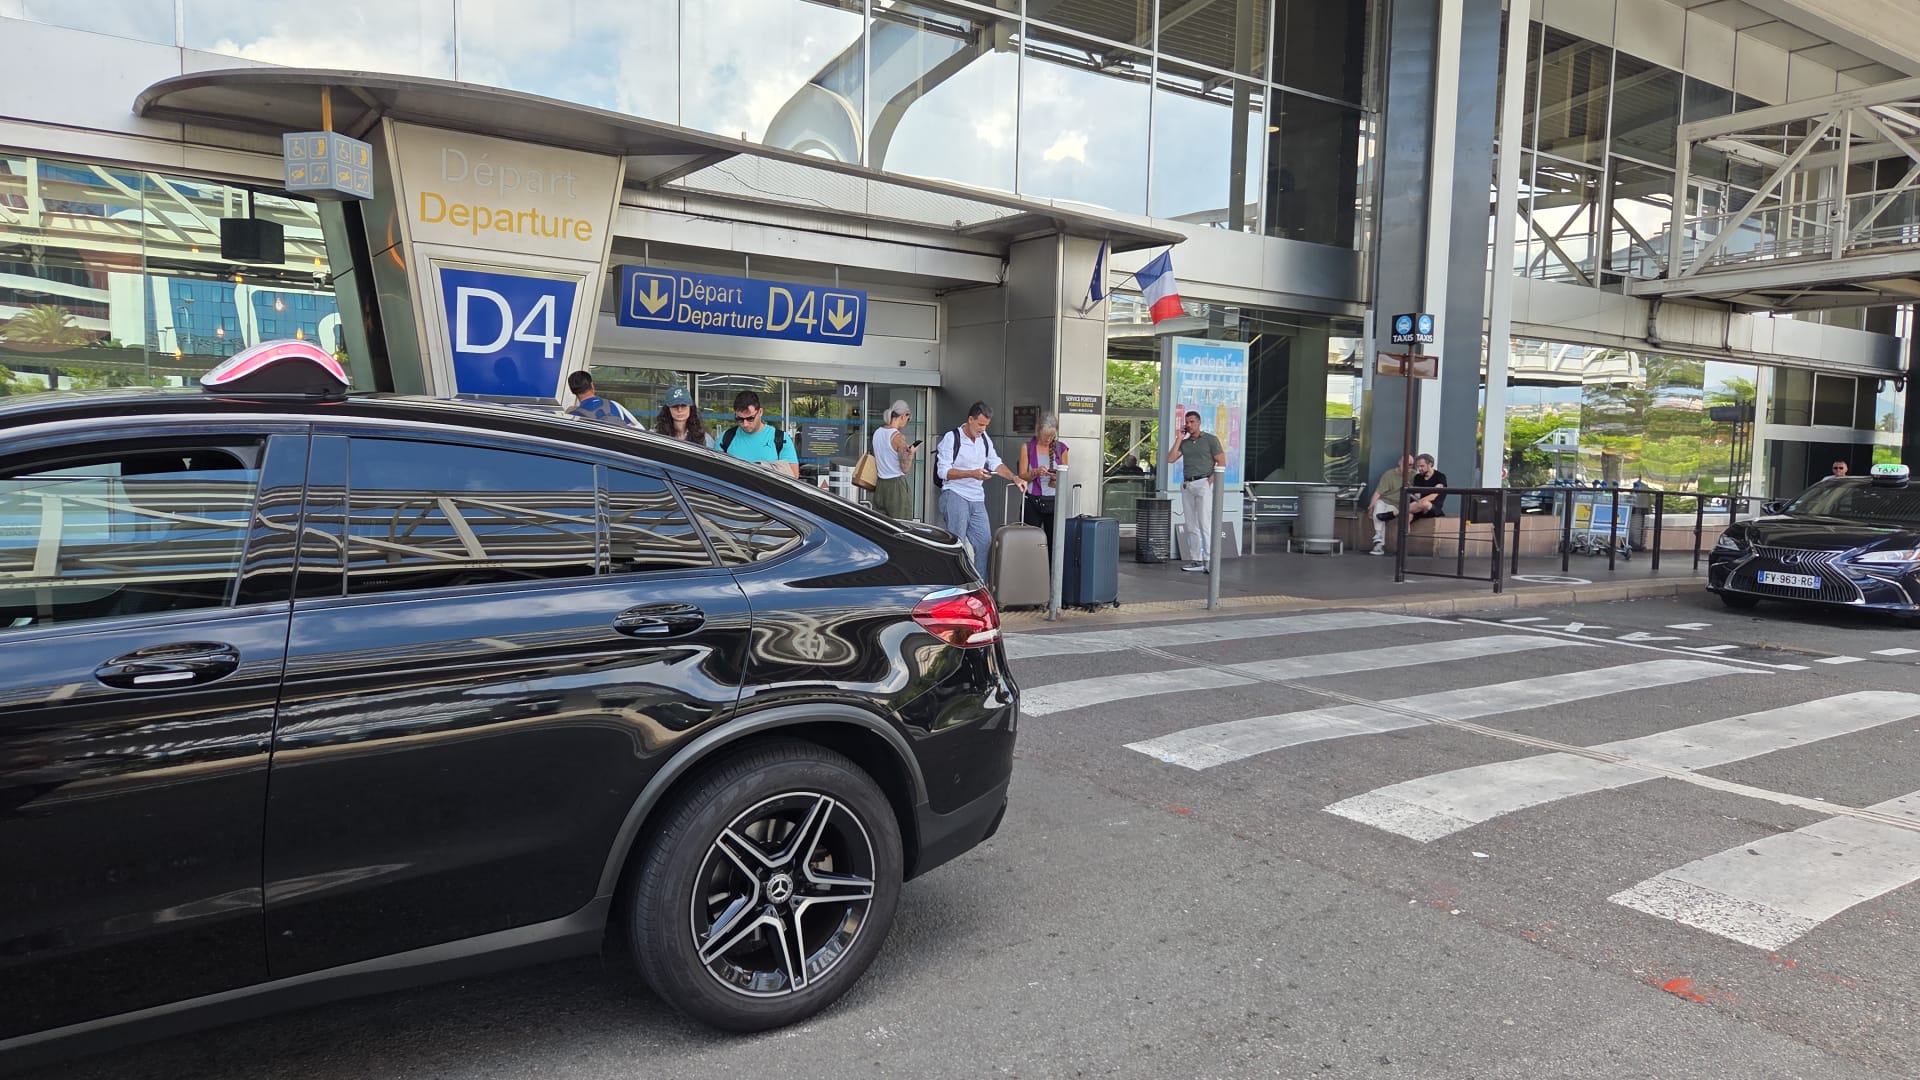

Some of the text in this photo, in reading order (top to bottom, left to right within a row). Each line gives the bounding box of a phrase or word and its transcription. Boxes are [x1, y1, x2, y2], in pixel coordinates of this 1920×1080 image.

[440, 147, 577, 199] Départ
[420, 191, 593, 242] Departure
[680, 277, 742, 305] Départ
[456, 286, 562, 358] D4
[677, 303, 764, 330] Departure
[766, 286, 817, 334] D4
[1393, 334, 1414, 343] TAXIS
[1416, 333, 1433, 342] TAXIS
[843, 384, 858, 397] D4
